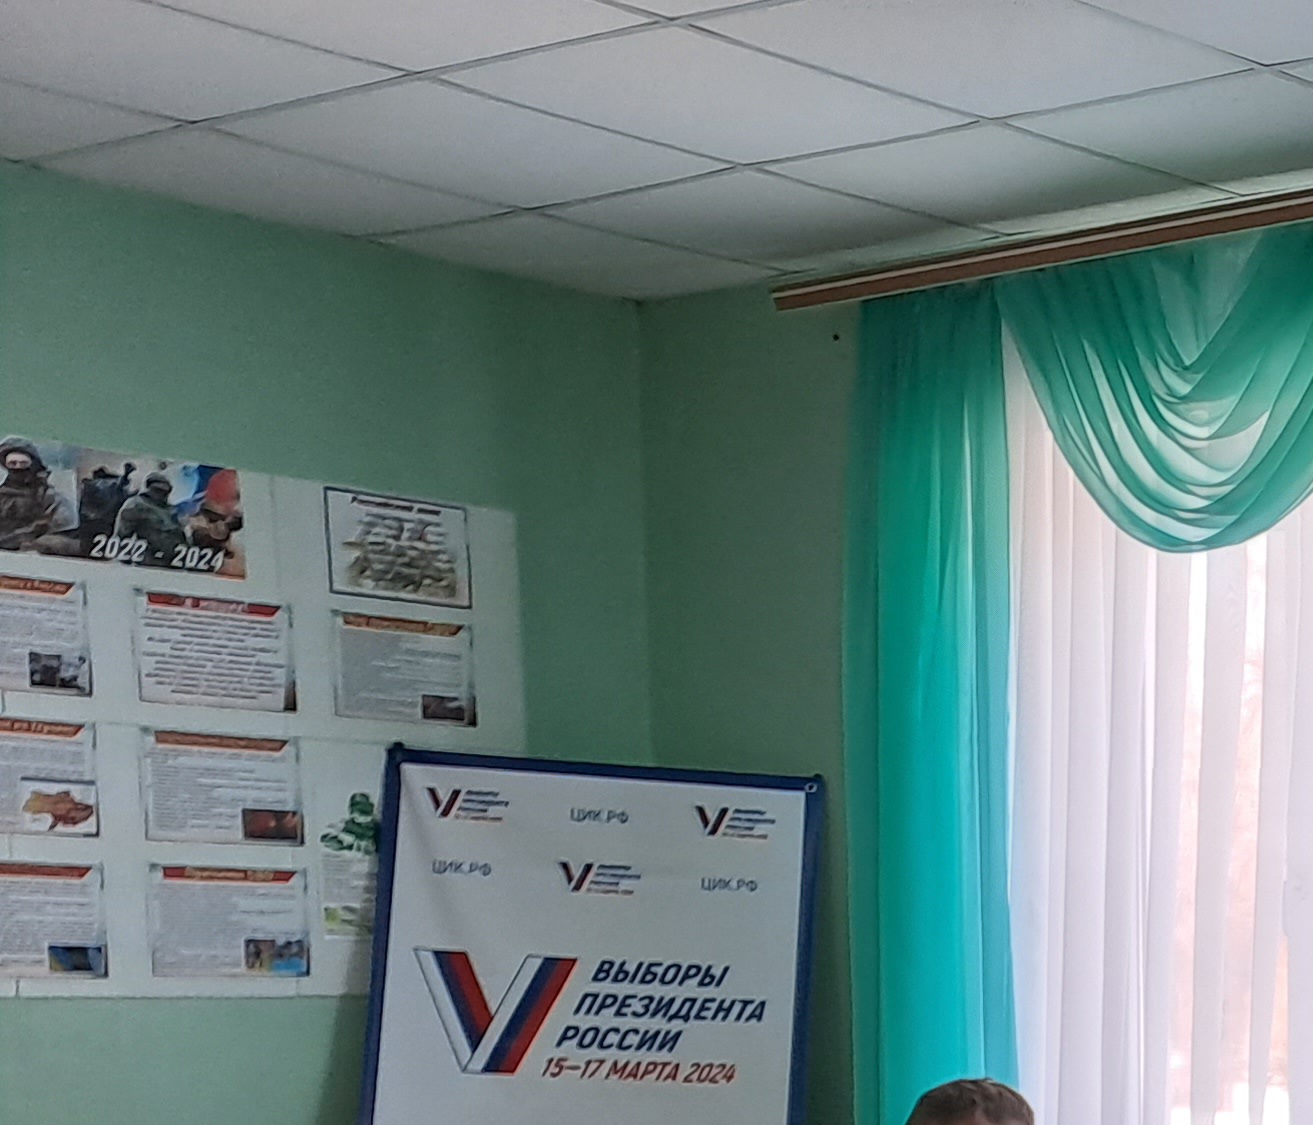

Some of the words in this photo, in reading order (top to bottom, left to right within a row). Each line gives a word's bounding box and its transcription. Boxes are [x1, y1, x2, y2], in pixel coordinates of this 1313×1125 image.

[89, 533, 149, 563] 2022
[170, 544, 226, 573] 2024
[570, 807, 629, 824] ЦИК.РФ
[431, 859, 492, 877] ЦИК.РФ
[700, 877, 758, 892] ЦИК.РФ
[592, 959, 731, 988] ВЫБОРЫ
[573, 992, 767, 1023] ПРЕЗИДЕНТА
[555, 1025, 683, 1053] РОССИИ
[605, 1060, 681, 1081] МАРТА
[682, 1062, 737, 1084] 2024
